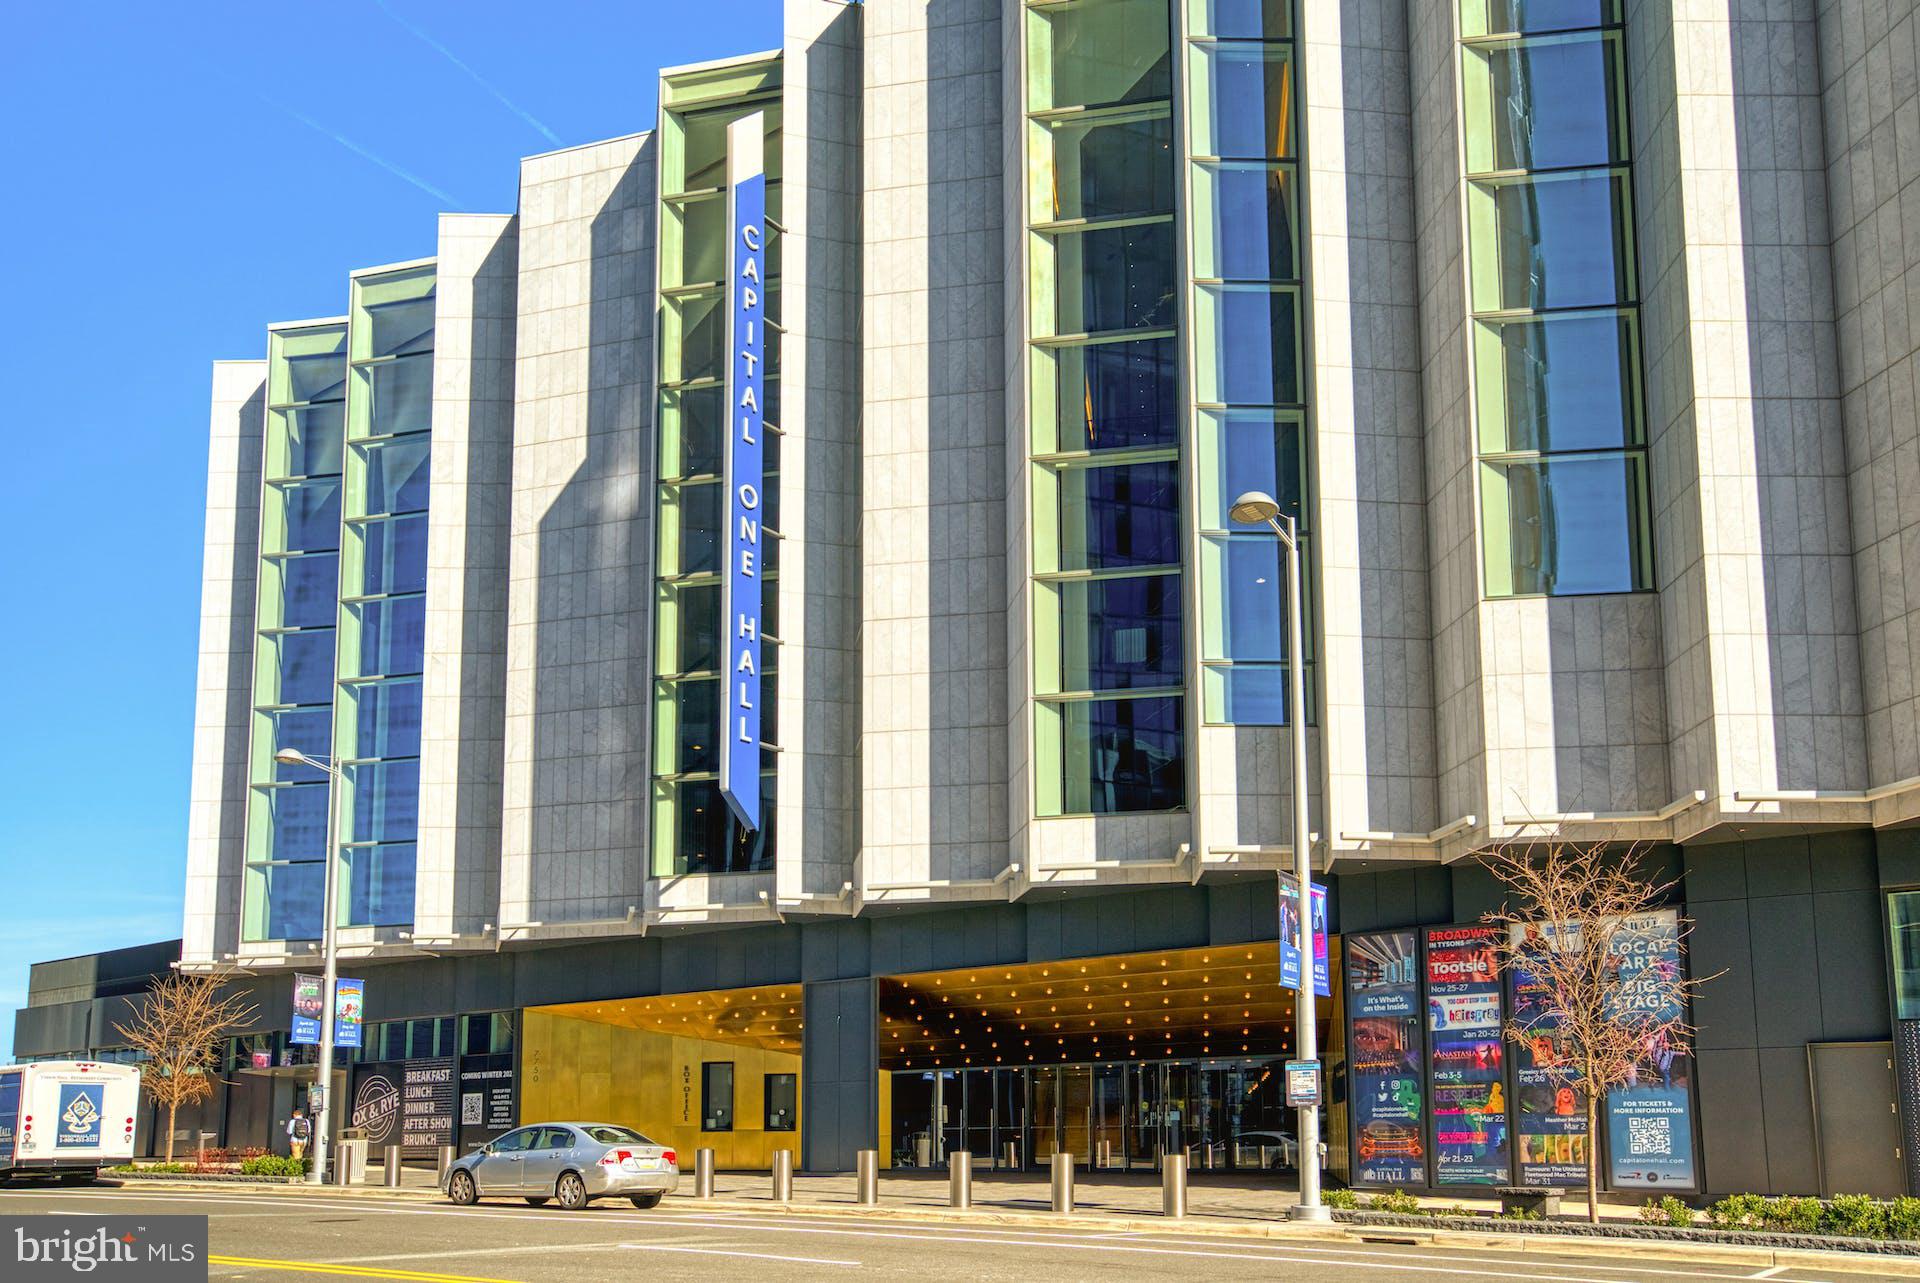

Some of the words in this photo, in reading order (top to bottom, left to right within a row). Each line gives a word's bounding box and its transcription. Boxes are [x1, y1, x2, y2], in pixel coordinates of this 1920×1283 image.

[740, 224, 760, 445] CAPITAL
[738, 484, 759, 577] ONE
[738, 613, 756, 743] HALL
[1437, 940, 1465, 948] TYSONS
[1431, 960, 1487, 975] Tootsie
[1431, 985, 1447, 993] Nov
[1447, 984, 1468, 992] 25-27
[1367, 996, 1378, 1004] It's
[1379, 995, 1404, 1004] What's
[1449, 1008, 1500, 1023] hairspray
[1477, 1029, 1500, 1038] 20-22
[1433, 1049, 1477, 1058] ANASTASIA
[405, 1069, 450, 1083] BREAKFAST
[461, 1072, 481, 1080] COMING
[482, 1070, 503, 1079] WINTER
[1435, 1071, 1448, 1079] Feb
[1448, 1071, 1462, 1079] 3-5
[1519, 1074, 1534, 1082] Feb
[1534, 1074, 1546, 1082] 26
[405, 1086, 433, 1098] LUNCH
[352, 1107, 367, 1126] OX
[369, 1103, 379, 1118] &
[380, 1092, 400, 1113] RYE
[405, 1102, 435, 1114] DINNER
[404, 1118, 429, 1130] AFTER
[403, 1134, 437, 1146] BRUNCH
[1438, 1155, 1451, 1164] Apr
[1452, 1154, 1474, 1163] 21-23
[1377, 1171, 1406, 1180] HALL
